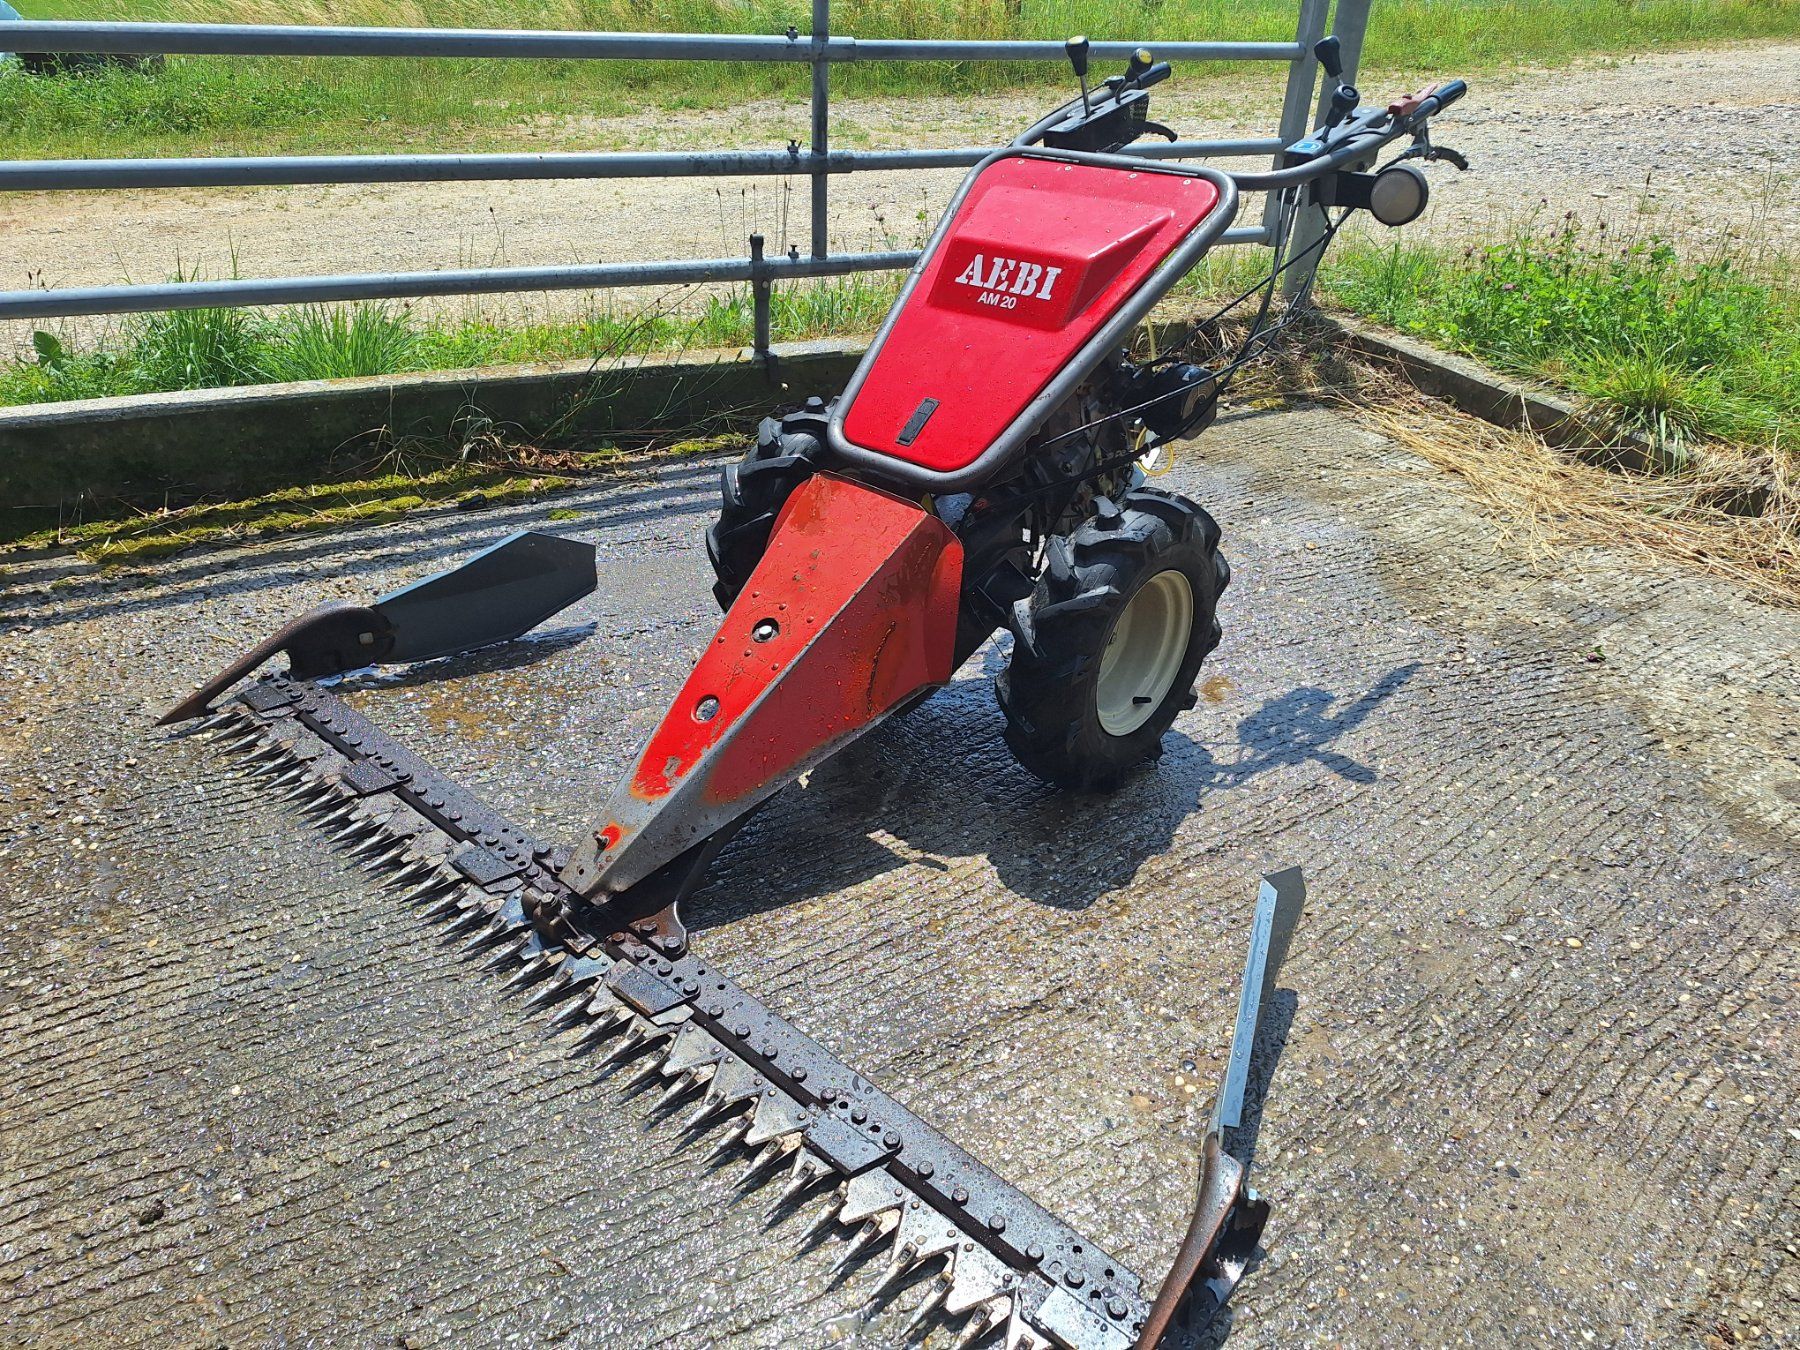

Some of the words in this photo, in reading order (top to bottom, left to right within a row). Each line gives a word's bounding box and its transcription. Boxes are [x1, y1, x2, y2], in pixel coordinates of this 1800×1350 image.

[955, 254, 1062, 300] AEBI
[977, 291, 1000, 306] AM
[1000, 295, 1017, 309] 20
